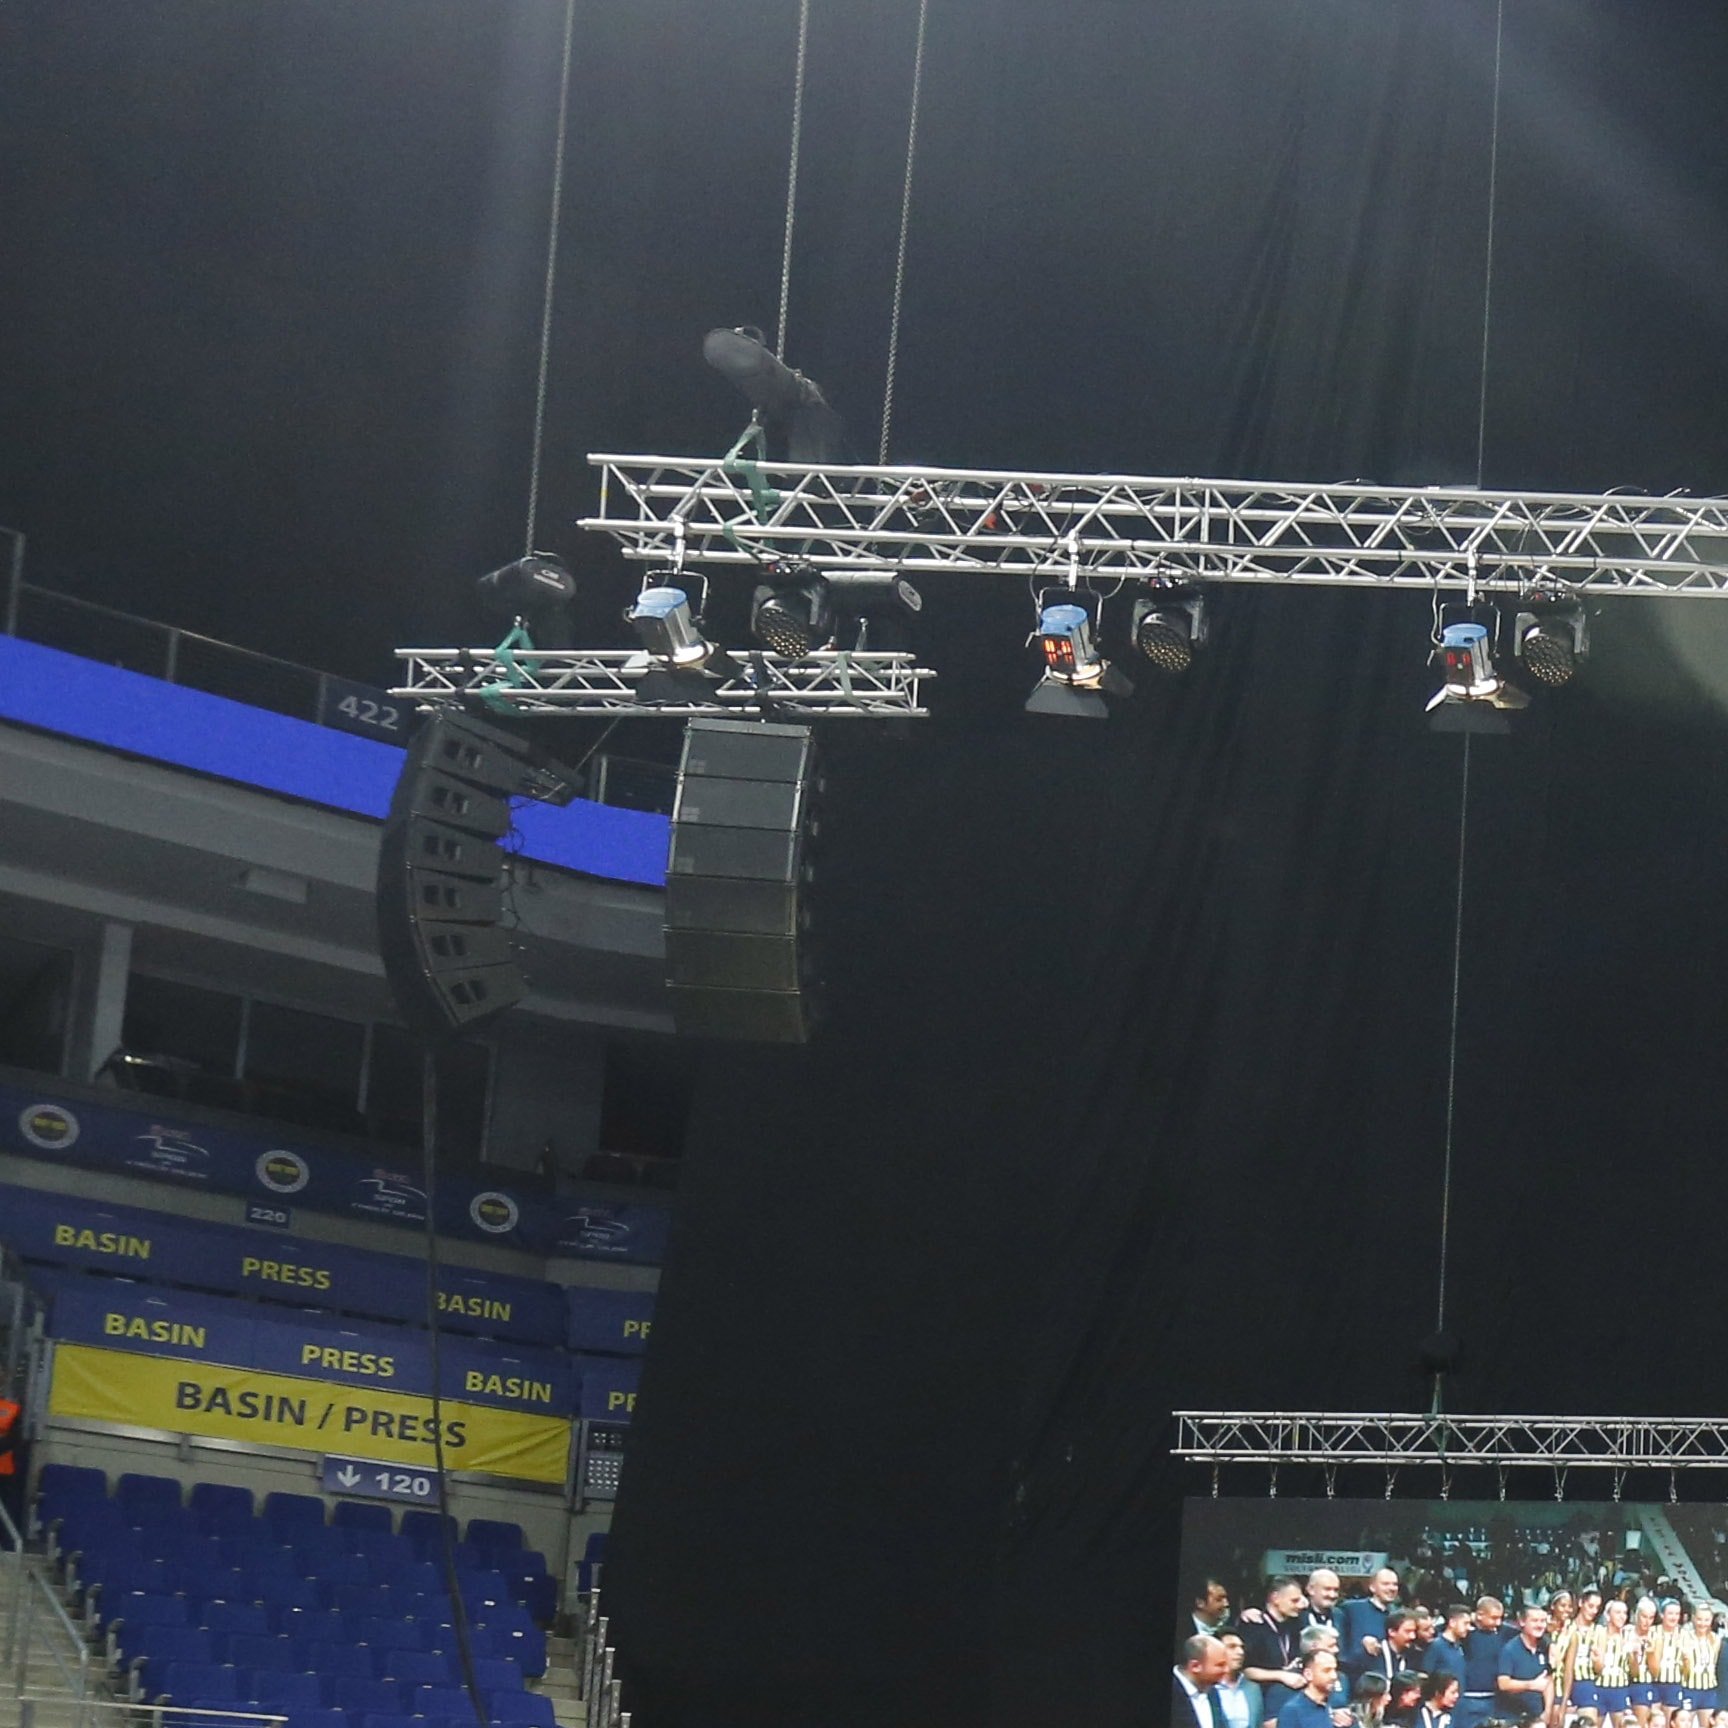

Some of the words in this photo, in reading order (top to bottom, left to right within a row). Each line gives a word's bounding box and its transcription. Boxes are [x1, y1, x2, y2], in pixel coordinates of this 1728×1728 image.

[338, 695, 399, 731] 422
[249, 1206, 287, 1224] 220
[54, 1223, 152, 1260] BASIN
[241, 1256, 333, 1290] PRESS
[104, 1312, 207, 1349] BASIN
[301, 1343, 396, 1378] PRESS
[465, 1370, 552, 1404] BASIN
[175, 1380, 307, 1426] BASIN
[316, 1403, 334, 1431] /
[343, 1405, 467, 1449] PRESS
[375, 1471, 431, 1497] 120
